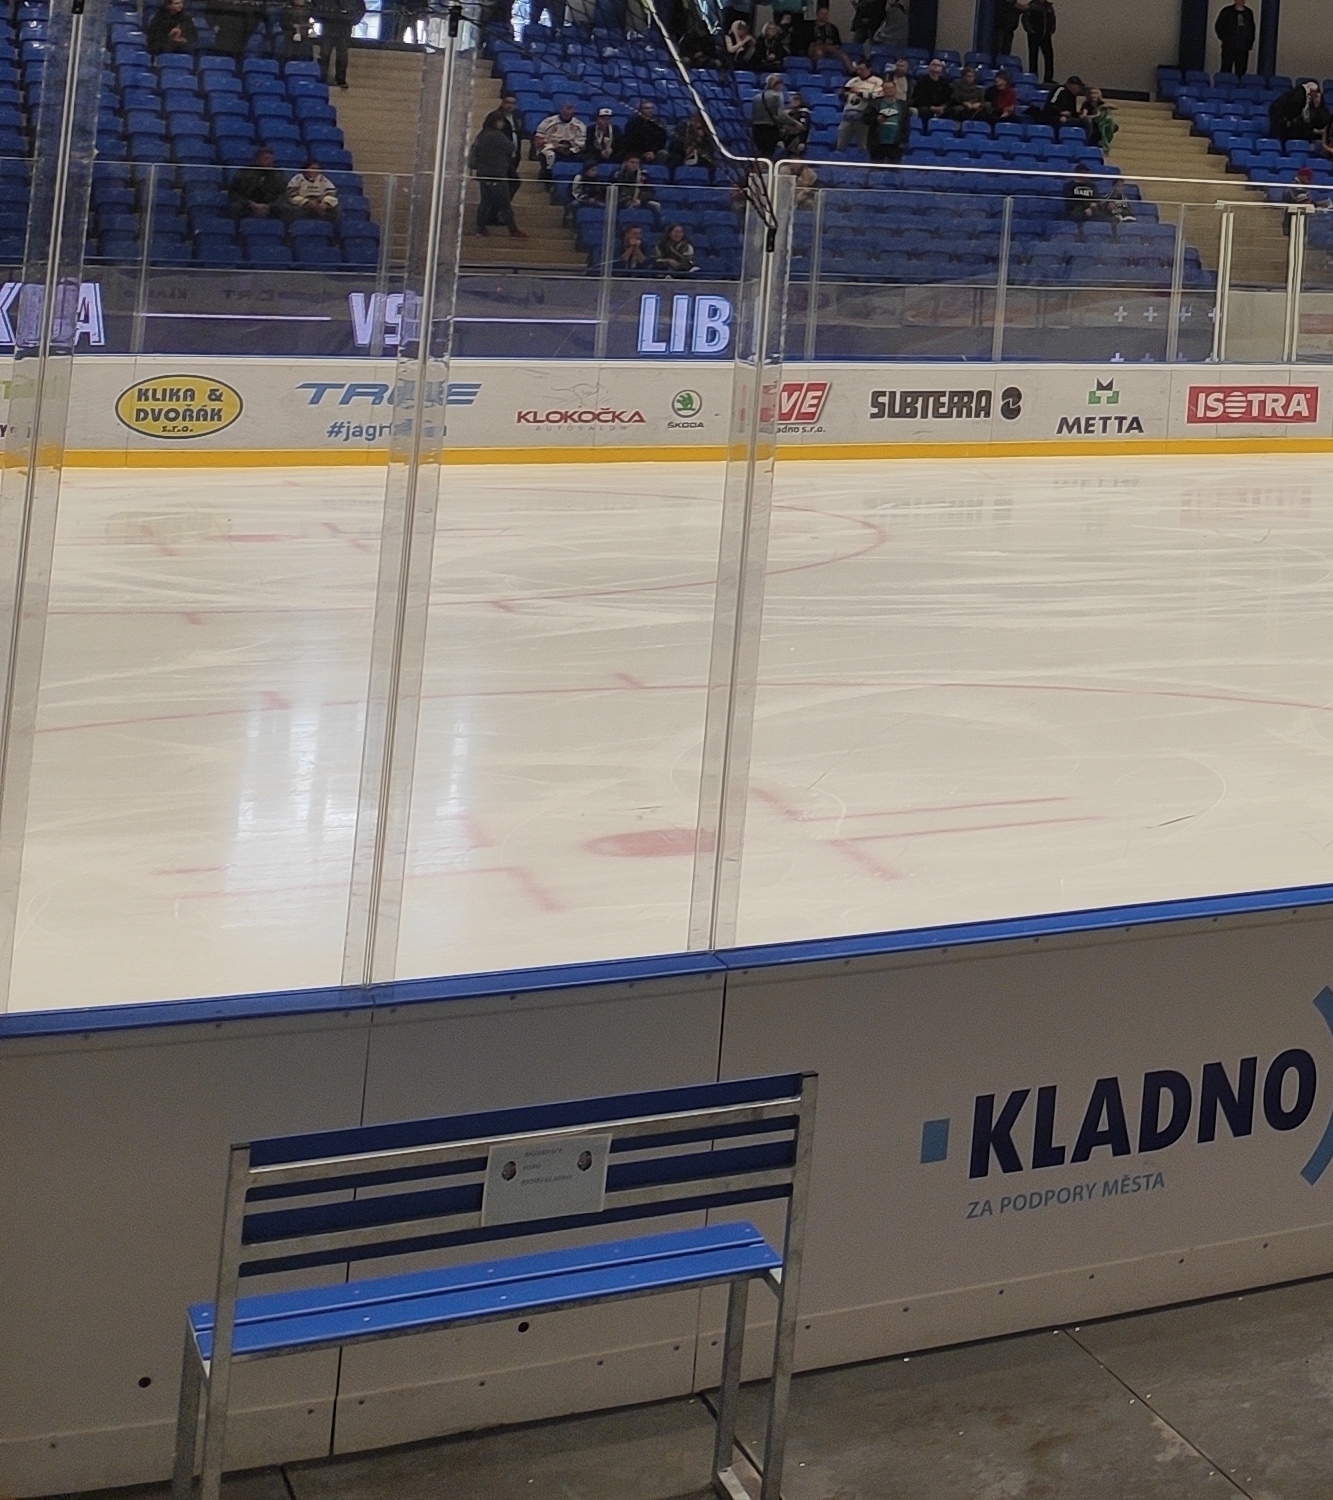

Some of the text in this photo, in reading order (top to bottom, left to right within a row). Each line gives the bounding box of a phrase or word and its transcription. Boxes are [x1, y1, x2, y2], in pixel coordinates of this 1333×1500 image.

[637, 294, 734, 354] LIB
[136, 388, 223, 402] KLIKA &
[869, 390, 993, 419] SUBTERRA
[1196, 392, 1311, 418] ISOTRA
[135, 404, 223, 422] DVOŘÁK
[516, 407, 647, 424] KLOKOČKA
[161, 425, 194, 433] s.r.o.
[1056, 416, 1144, 434] METTA
[968, 1048, 1318, 1180] KLADNO
[966, 1171, 1166, 1220] ZA PODPORY MĚSTA
